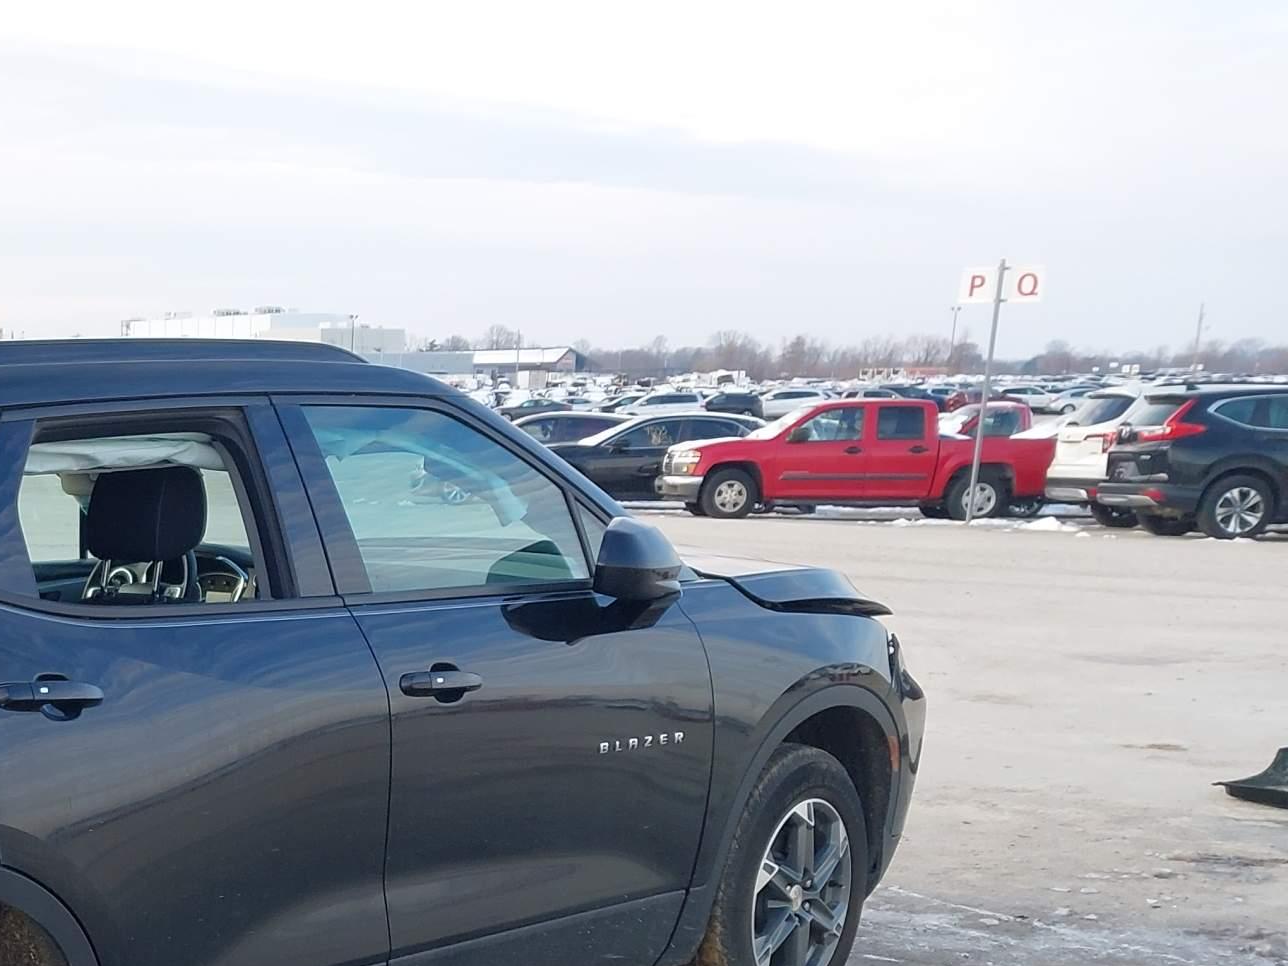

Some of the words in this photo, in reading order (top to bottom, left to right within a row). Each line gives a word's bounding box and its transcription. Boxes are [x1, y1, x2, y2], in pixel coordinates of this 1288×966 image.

[968, 274, 986, 297] P
[1017, 272, 1038, 296] Q
[599, 731, 684, 754] BLAZER
